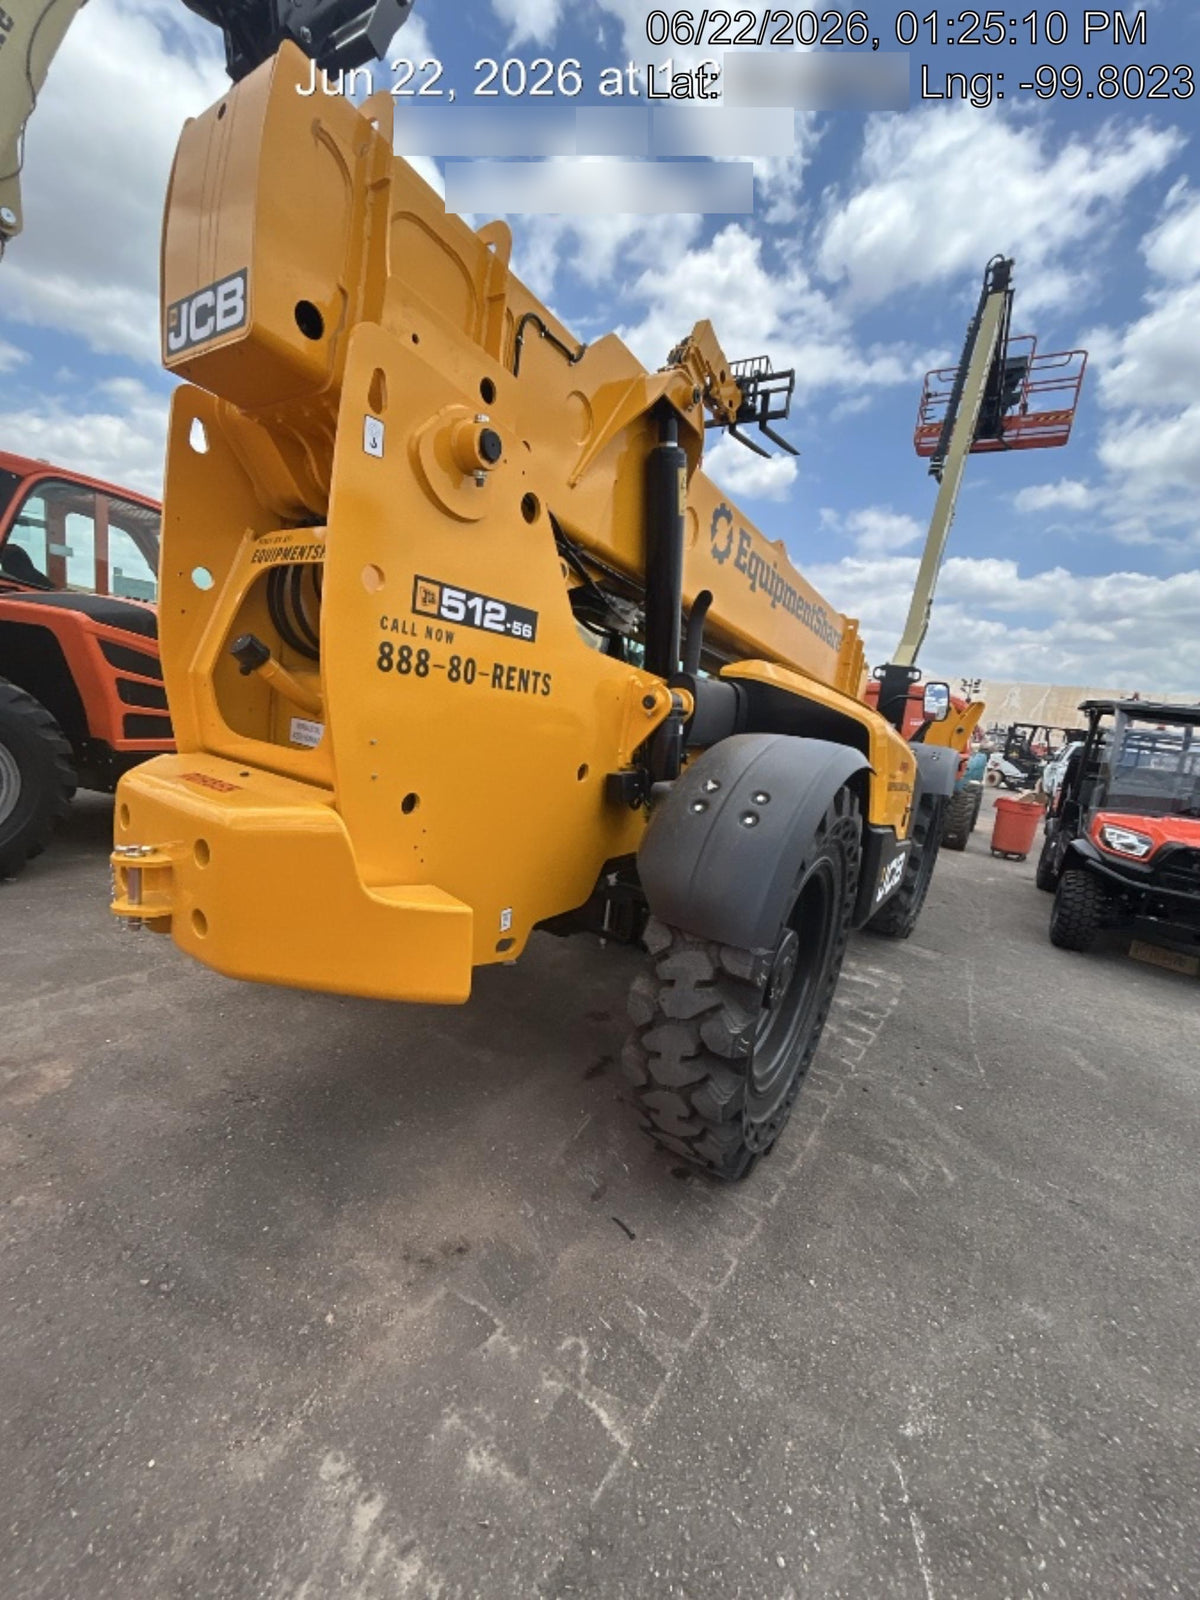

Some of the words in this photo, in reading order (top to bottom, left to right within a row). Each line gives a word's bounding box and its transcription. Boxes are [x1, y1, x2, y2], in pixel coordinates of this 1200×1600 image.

[168, 276, 245, 350] JCB
[379, 615, 418, 637] CALL
[424, 625, 455, 645] NOW
[376, 641, 552, 697] 888-80-RENTS
